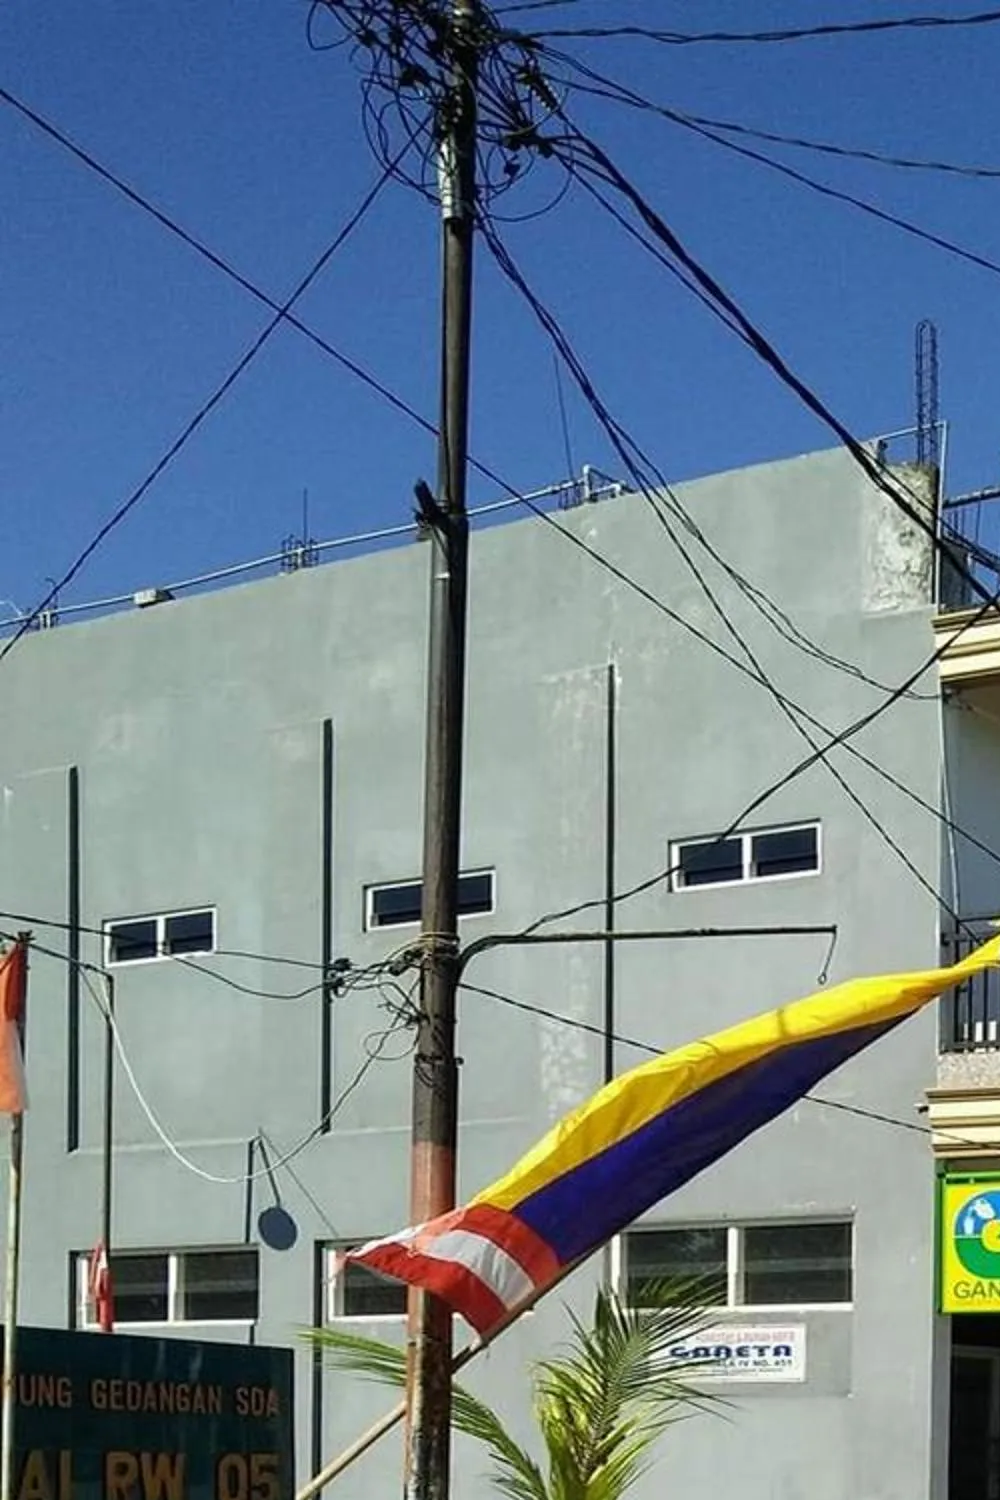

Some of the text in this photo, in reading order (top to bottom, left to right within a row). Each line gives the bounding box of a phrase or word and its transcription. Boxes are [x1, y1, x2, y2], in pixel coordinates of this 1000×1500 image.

[669, 1345, 793, 1358] GANETA
[11, 1374, 281, 1417] UNG GEDANGAN SDA
